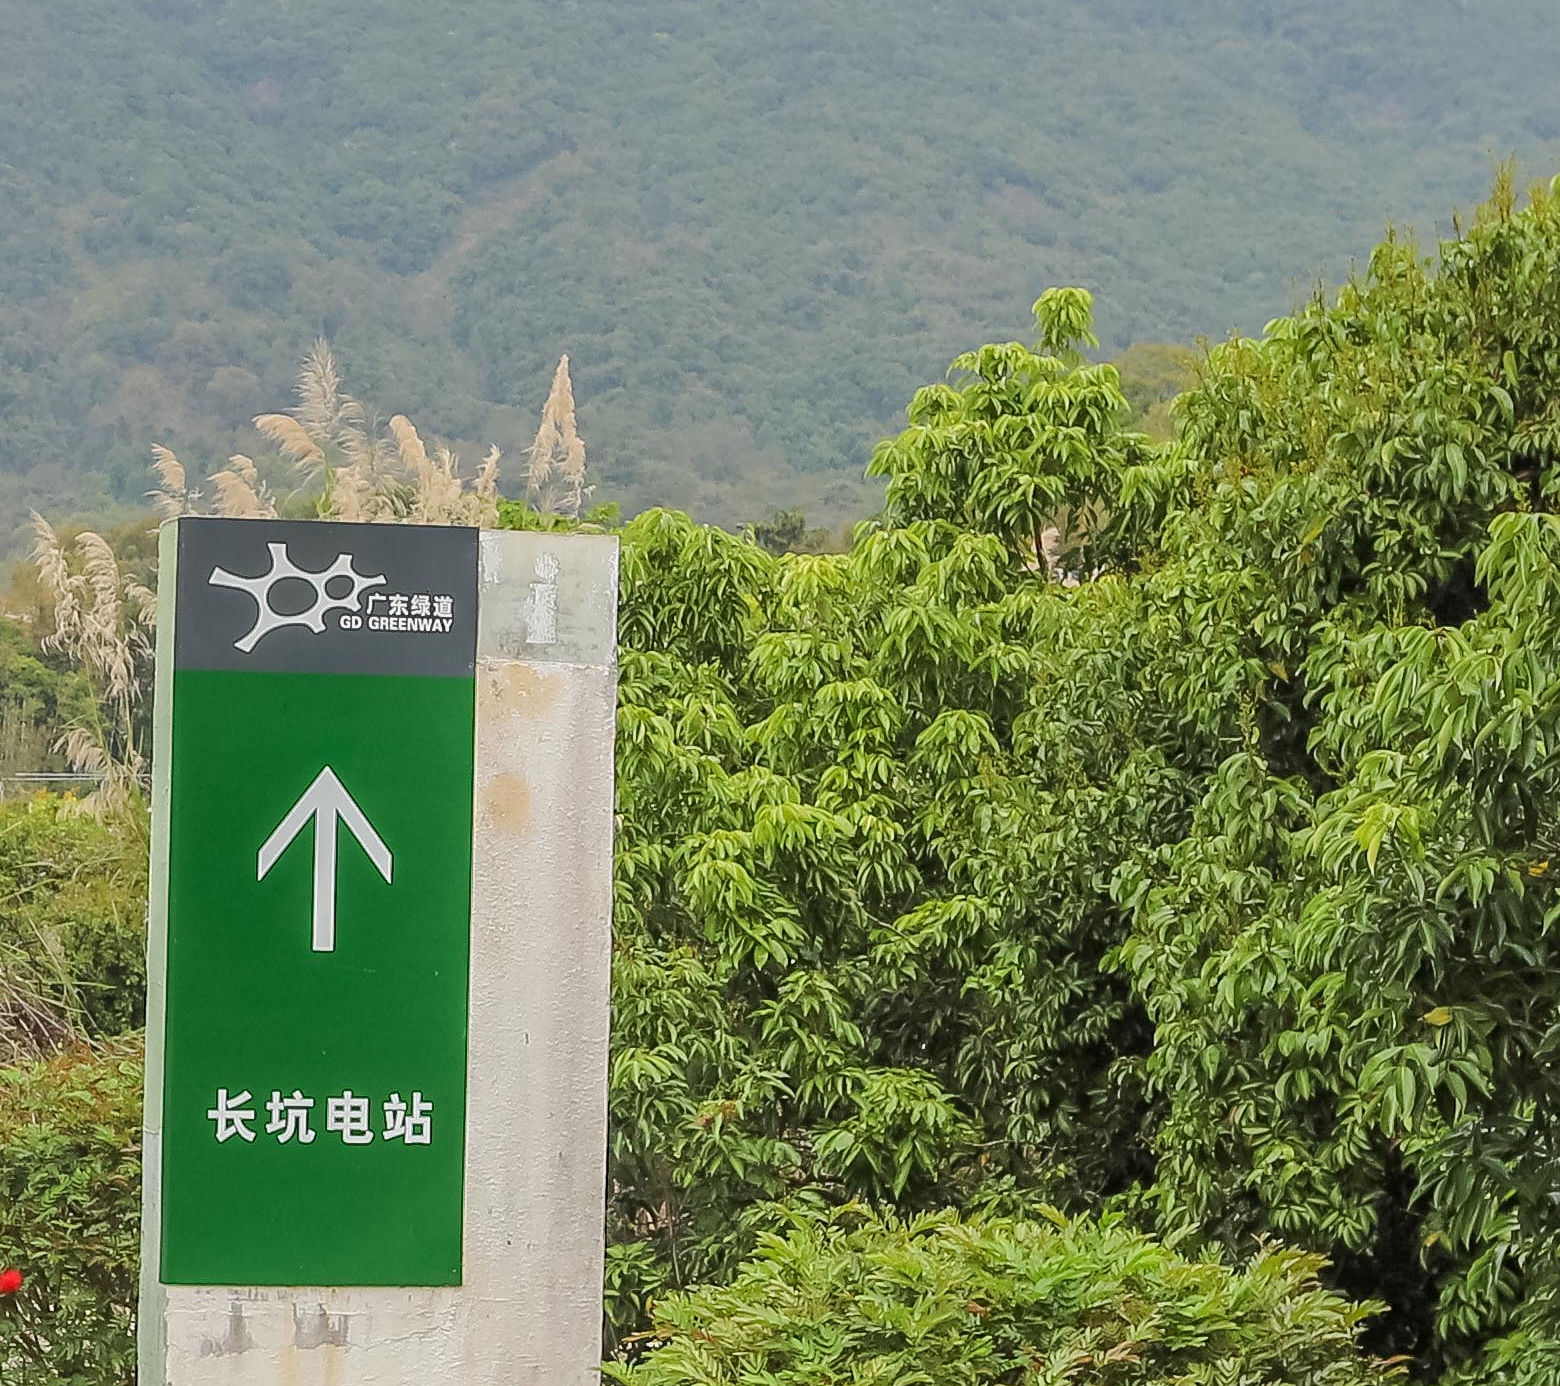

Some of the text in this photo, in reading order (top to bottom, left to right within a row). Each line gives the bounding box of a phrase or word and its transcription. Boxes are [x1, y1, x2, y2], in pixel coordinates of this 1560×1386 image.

[366, 593, 453, 618] 广东绿道
[339, 615, 453, 633] GD GREENWAY
[207, 1088, 433, 1144] 长坑电站
